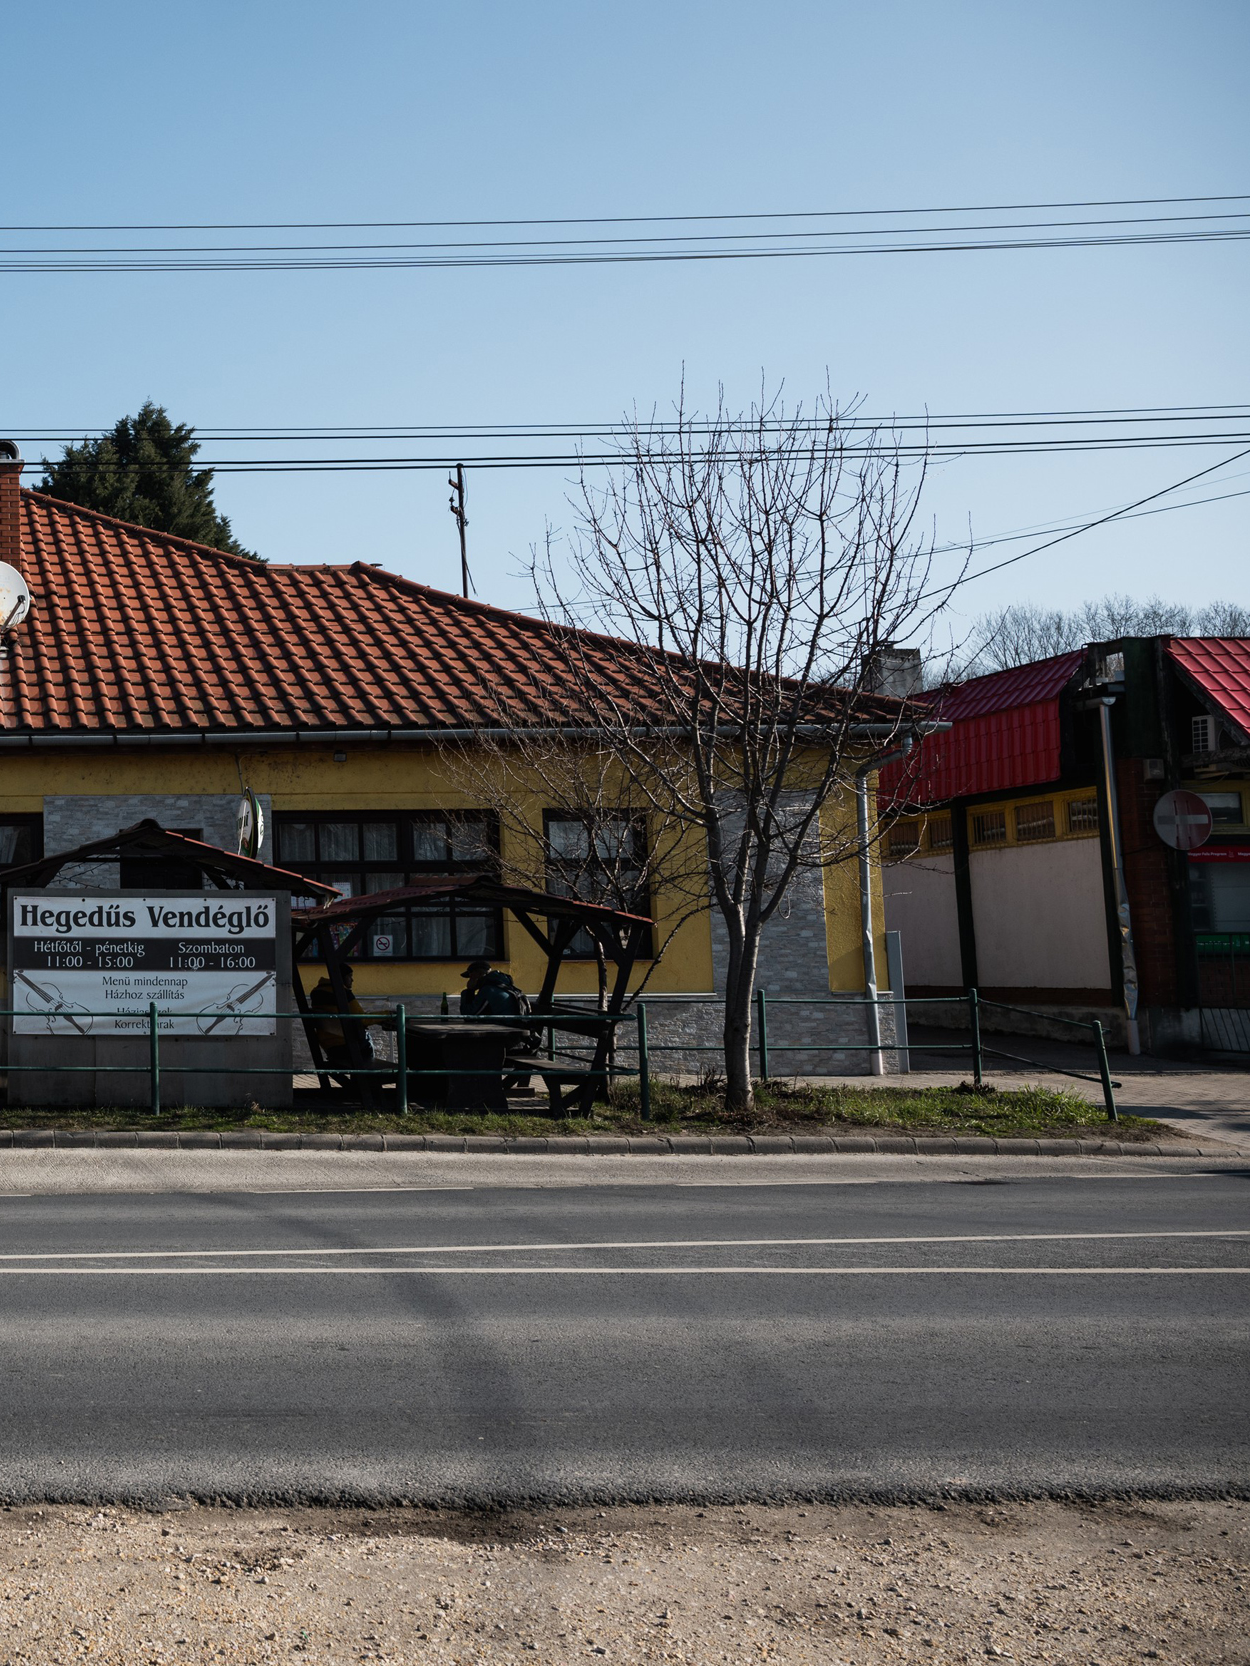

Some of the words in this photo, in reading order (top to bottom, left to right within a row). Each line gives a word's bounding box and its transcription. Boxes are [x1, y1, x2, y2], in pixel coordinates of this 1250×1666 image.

[20, 904, 136, 934] Hegedűs
[146, 905, 270, 934] Vendéglő
[34, 941, 82, 953] Hétfőtől
[95, 941, 145, 957] pénetkig
[178, 941, 245, 954] Szombaton
[46, 956, 83, 968] 11:00
[97, 956, 134, 968] 15:00
[169, 956, 205, 968] 11:00
[220, 956, 256, 968] 16:00
[102, 976, 130, 986] Menü
[133, 976, 188, 989] mindennap
[105, 989, 143, 999] Házhoz
[146, 989, 185, 999] szállítás
[114, 1019, 150, 1029] Korrekt
